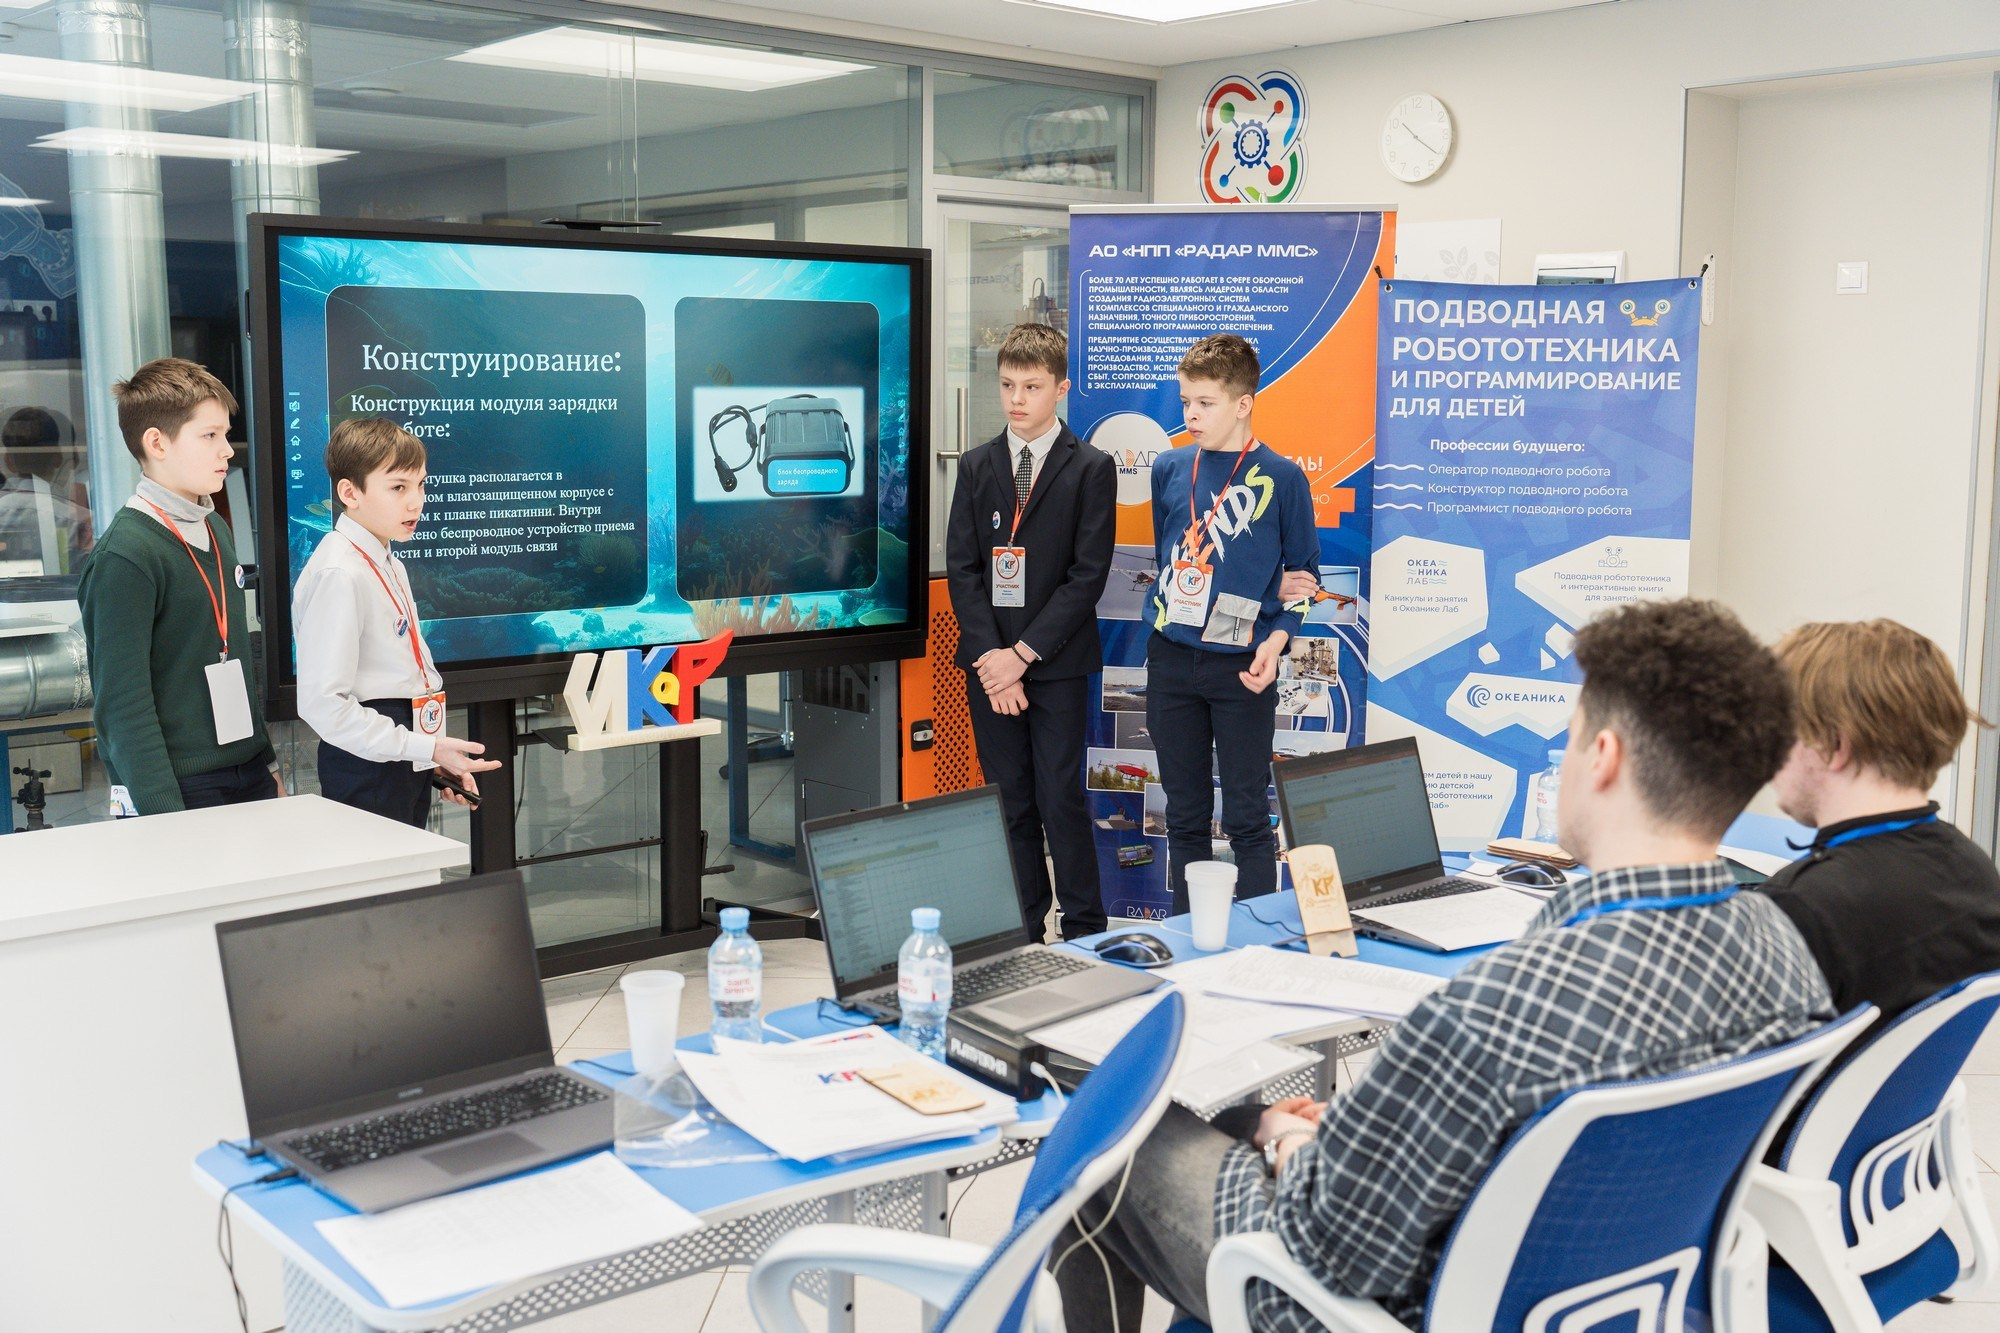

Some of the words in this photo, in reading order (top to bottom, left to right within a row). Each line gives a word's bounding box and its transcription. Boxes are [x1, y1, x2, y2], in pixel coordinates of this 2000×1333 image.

[1412, 97, 1422, 109] 12
[1400, 105, 1407, 115] 11
[1439, 112, 1445, 123] 2
[1389, 118, 1399, 129] 10
[1442, 128, 1448, 139] 3
[1386, 135, 1391, 145] 9
[1390, 151, 1396, 162] 8
[1400, 163, 1406, 174] 7
[1428, 160, 1434, 170] 5
[1414, 166, 1420, 177] 6
[1089, 244, 1117, 257] АО
[1122, 244, 1170, 257] «НПП
[1174, 244, 1252, 260] «РАДАР
[1258, 244, 1318, 257] ММС»
[1089, 276, 1113, 284] БОЛЕЕ
[1115, 276, 1124, 284] 70
[1125, 276, 1138, 284] ЛЕТ
[1140, 276, 1179, 284] УСПЕШНО
[1181, 276, 1218, 284] РАБОТАЕТ
[1220, 276, 1224, 284] В
[1226, 276, 1250, 284] СФЕРЕ
[1253, 275, 1303, 284] ОБОРОННОЙ
[1089, 286, 1167, 294] ПРОМЫШЛЕННОСТИ,
[1170, 286, 1202, 294] ЯВЛЯЯСЬ
[1204, 286, 1243, 294] ЛИДЕРОМ
[1246, 286, 1250, 294] В
[1252, 286, 1288, 294] ОБЛАСТИ
[1089, 295, 1131, 303] СОЗДАНИЯ
[1134, 295, 1217, 303] РАДИОЭЛЕКТРОННЫХ
[1219, 295, 1249, 303] СИСТЕМ
[1089, 304, 1094, 312] И
[1096, 304, 1150, 312] КОМПЛЕКСОВ
[1152, 304, 1213, 312] СПЕЦИАЛЬНОГО
[1216, 304, 1221, 312] И
[1224, 304, 1288, 312] ГРАЖДАНСКОГО
[1394, 300, 1605, 327] ПОДВОДНАЯ
[1089, 314, 1140, 322] НАЗНАЧЕНИЯ,
[1142, 314, 1177, 322] ТОЧНОГО
[1179, 314, 1256, 322] ПРИБОРОСТРОЕНИЯ,
[1089, 323, 1150, 331] СПЕЦИАЛЬНОГО
[1153, 323, 1217, 331] ПРОГРАММНОГО
[1219, 323, 1274, 331] ОБЕСПЕЧЕНИЯ.
[1089, 336, 1138, 344] ПРЕДПРИЯТИЕ
[1392, 337, 1680, 362] РОБОТОТЕХНИКА
[362, 344, 621, 377] Конструирование:
[1089, 355, 1153, 363] ИССЛЕДОВАНИЯ,
[1089, 364, 1151, 372] ПРОИЗВОДСТВО,
[1088, 373, 1110, 381] СБЫТ,
[1391, 371, 1408, 388] И
[1414, 371, 1681, 390] ПРОГРАММИРОВАНИЕ
[1088, 382, 1092, 391] В
[1094, 382, 1158, 391] ЭКСПЛУАТАЦИИ.
[351, 396, 474, 415] Конструкция
[480, 397, 543, 413] модуля
[549, 397, 617, 415] зарядки
[1390, 398, 1440, 418] ДЛЯ
[1447, 395, 1525, 418] ДЕТЕЙ
[1430, 439, 1509, 454] Профессии
[1513, 441, 1585, 456] будущего:
[1428, 463, 1488, 477] Оператор
[1491, 465, 1562, 477] подводного
[1566, 465, 1610, 478] робота
[469, 471, 553, 486] располагается
[556, 473, 562, 481] в
[447, 489, 556, 503] влагозащищенном
[560, 489, 605, 500] корпусе
[608, 488, 614, 496] с
[1428, 483, 1505, 496] Конструктор
[1508, 485, 1580, 496] подводного
[1584, 485, 1628, 497] робота
[433, 513, 440, 521] к
[444, 510, 486, 521] планке
[490, 506, 555, 520] пикатинни.
[559, 505, 601, 518] Внутри
[1427, 502, 1509, 515] Программист
[1512, 504, 1584, 516] подводного
[1587, 504, 1632, 517] робота
[440, 525, 524, 542] беспроводное
[527, 523, 591, 538] устройство
[594, 521, 635, 534] приема
[424, 548, 432, 557] и
[436, 544, 477, 559] второй
[481, 544, 523, 557] модуль
[526, 542, 558, 552] связи
[1407, 559, 1436, 567] ОКЕА
[1407, 577, 1429, 585] ЛАБ
[1554, 572, 1601, 582] Подводная
[1604, 573, 1671, 584] робототехника
[1568, 584, 1636, 593] интерактивные
[1638, 585, 1663, 593] книги
[1384, 594, 1425, 604] Каникулы
[1584, 594, 1600, 602] для
[1400, 605, 1440, 613] Океанике
[1442, 605, 1459, 613] Лаб
[1495, 692, 1566, 703] ОКЕАНИКА
[1470, 773, 1492, 781] нашу
